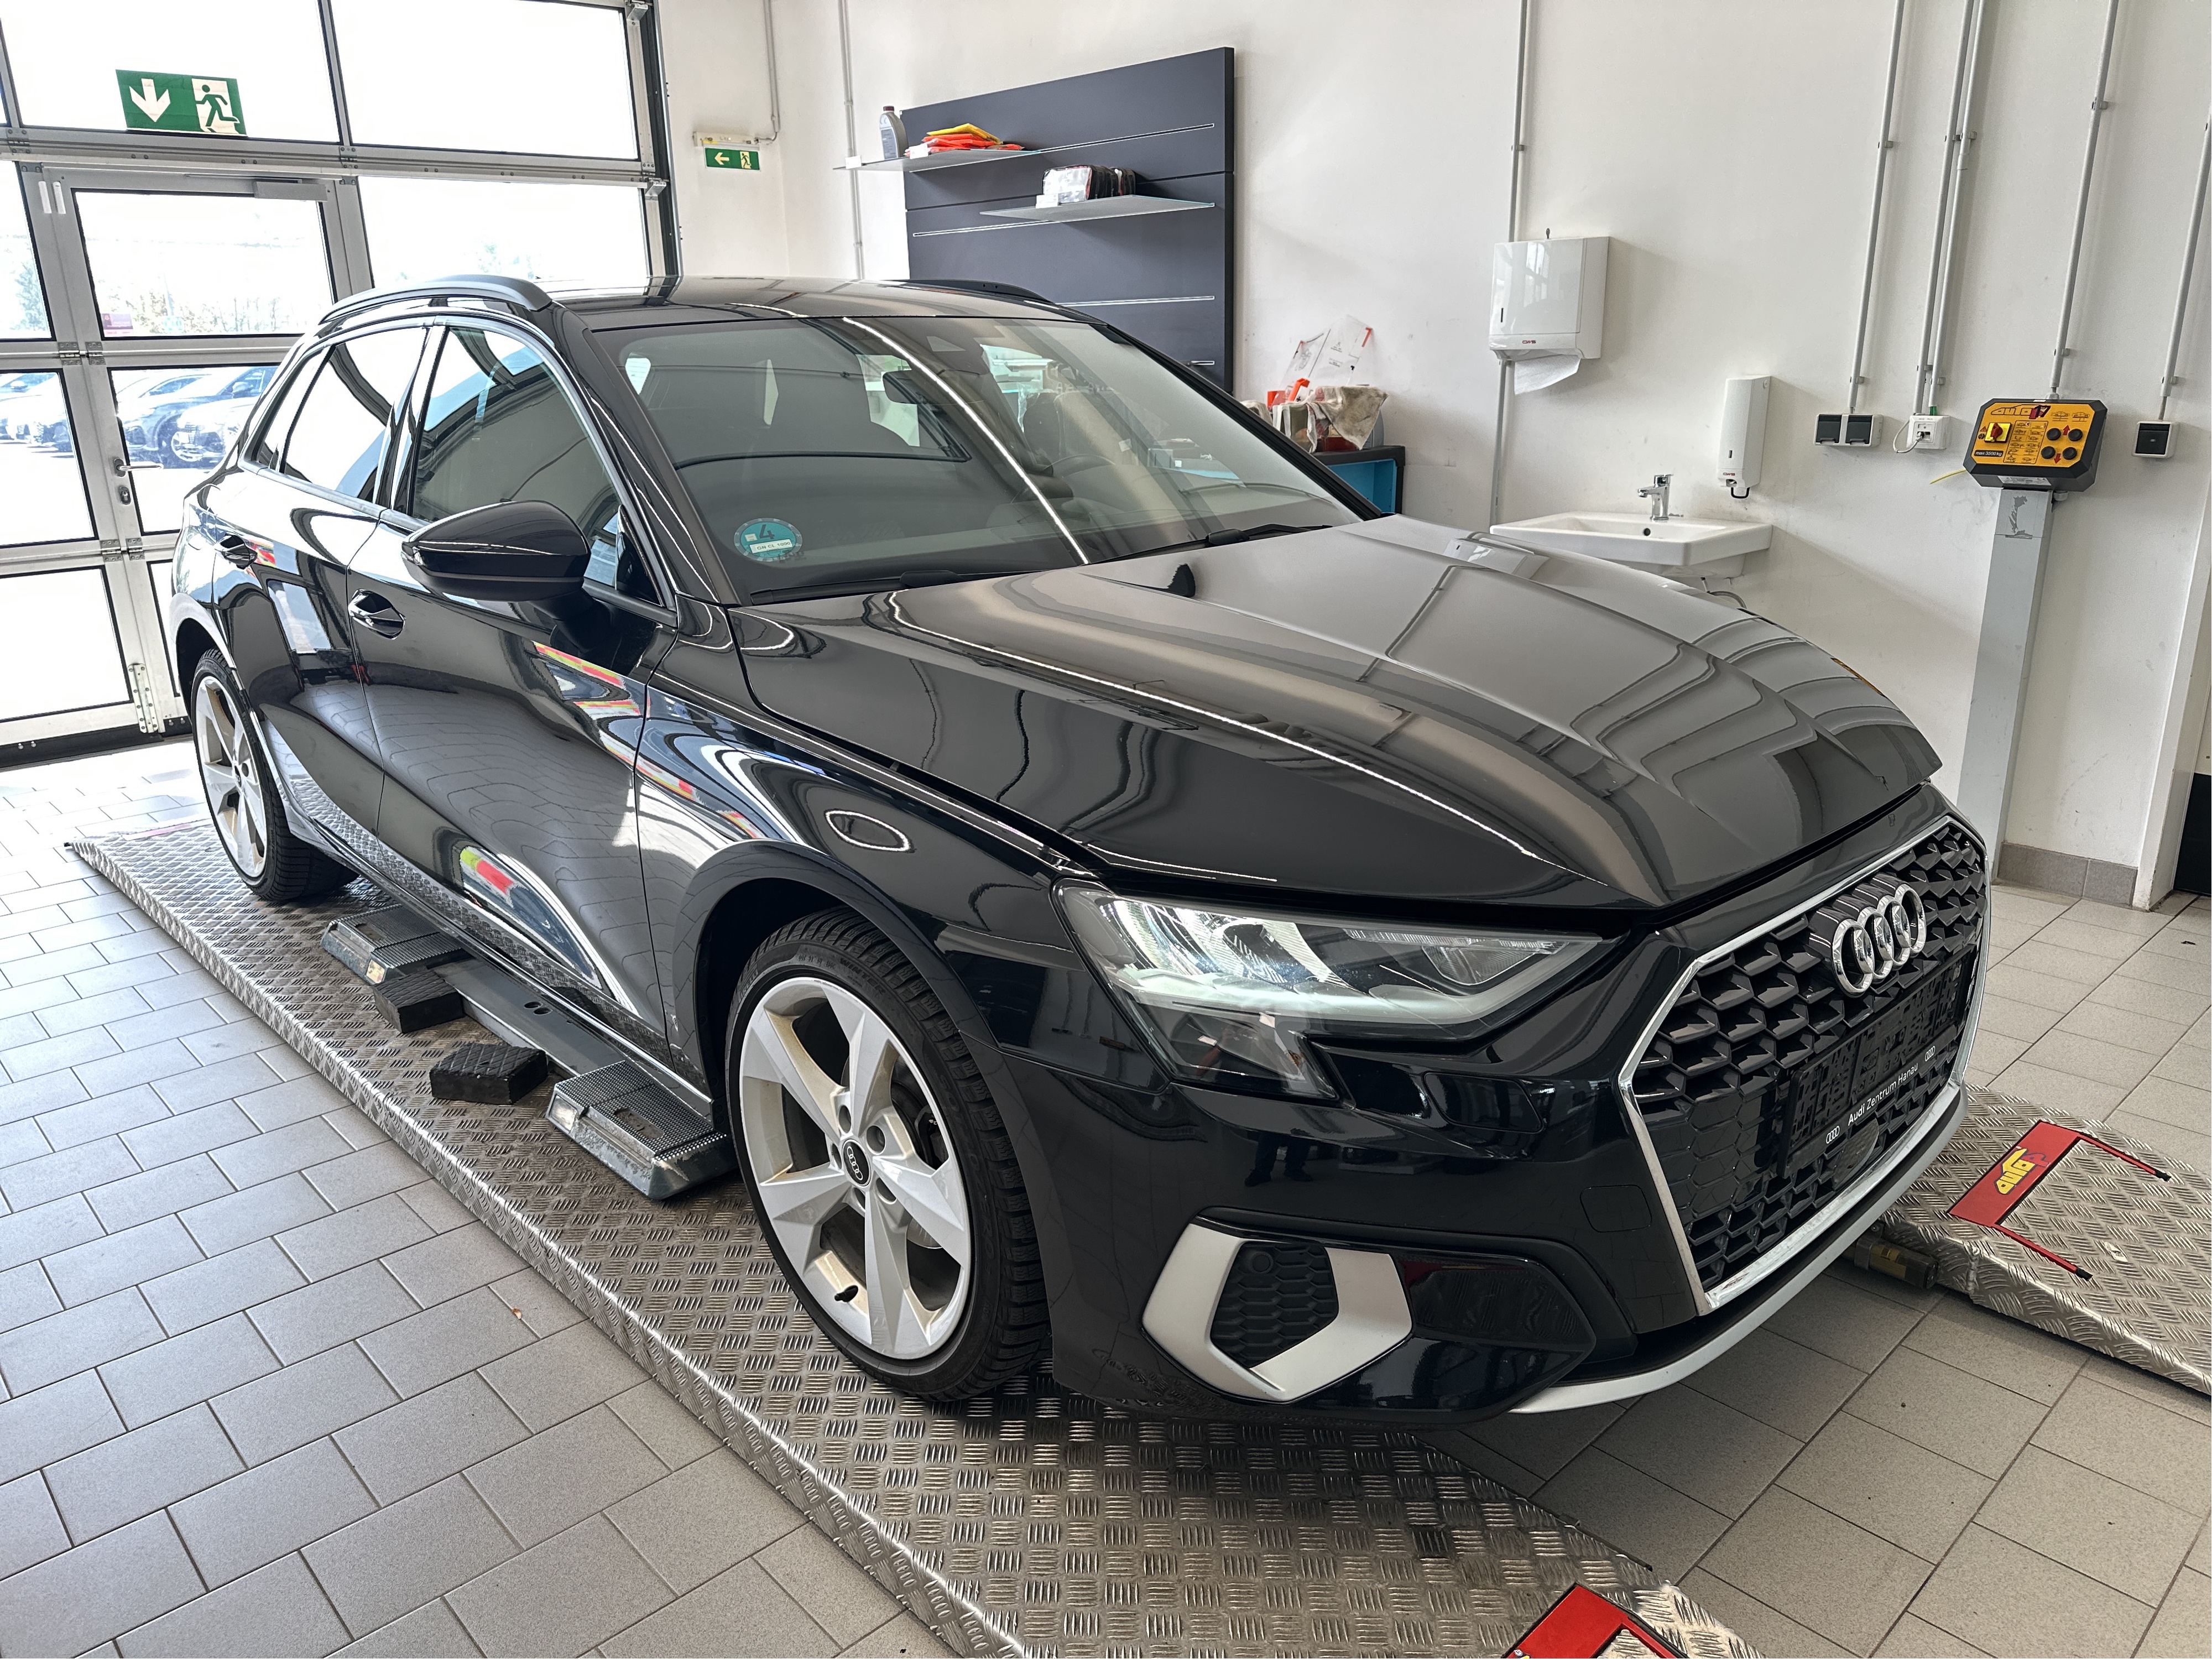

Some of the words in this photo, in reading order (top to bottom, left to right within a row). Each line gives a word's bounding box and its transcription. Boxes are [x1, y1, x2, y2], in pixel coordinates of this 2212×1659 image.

[759, 524, 775, 540] 4
[1848, 1104, 1865, 1126] Audi
[1866, 1081, 1897, 1111] Zentrum
[1898, 1063, 1918, 1086] Hanau
